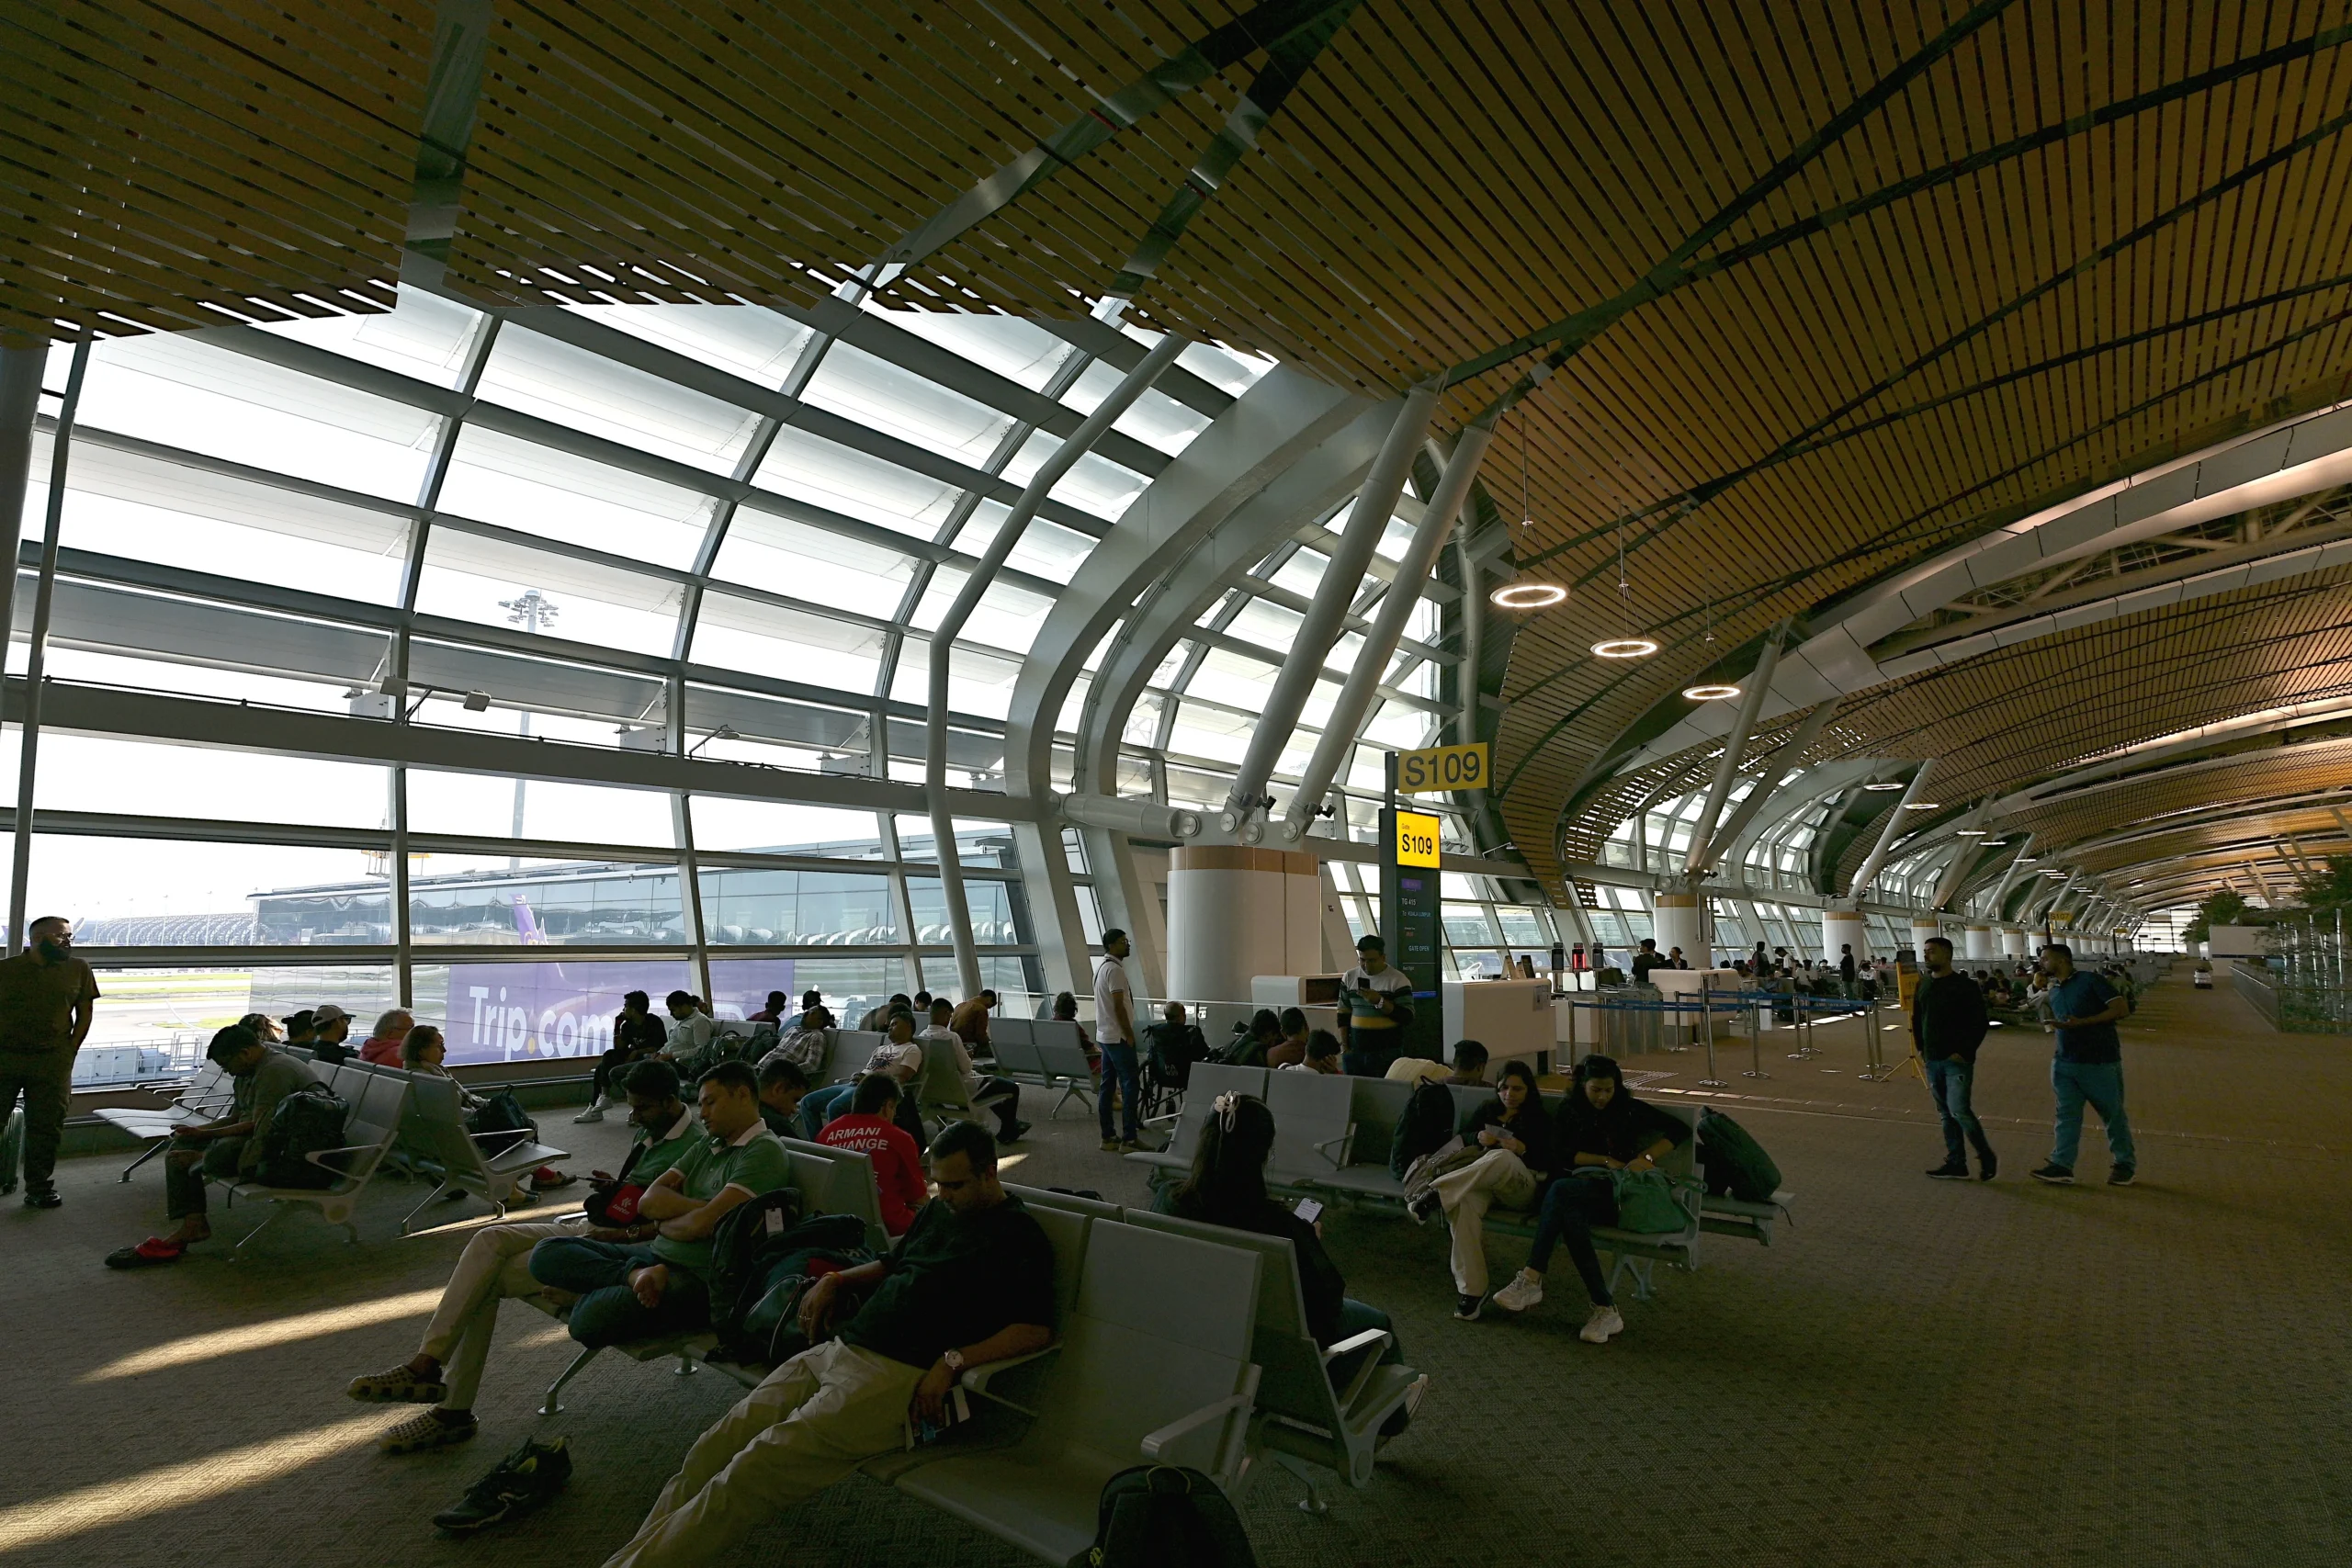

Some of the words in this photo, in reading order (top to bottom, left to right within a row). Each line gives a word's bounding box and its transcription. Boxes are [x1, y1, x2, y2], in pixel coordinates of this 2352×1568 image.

[1405, 751, 1480, 786] S109
[1402, 833, 1432, 855] S109
[469, 986, 615, 1061] Trip.com
[826, 1127, 881, 1143] ARMANI
